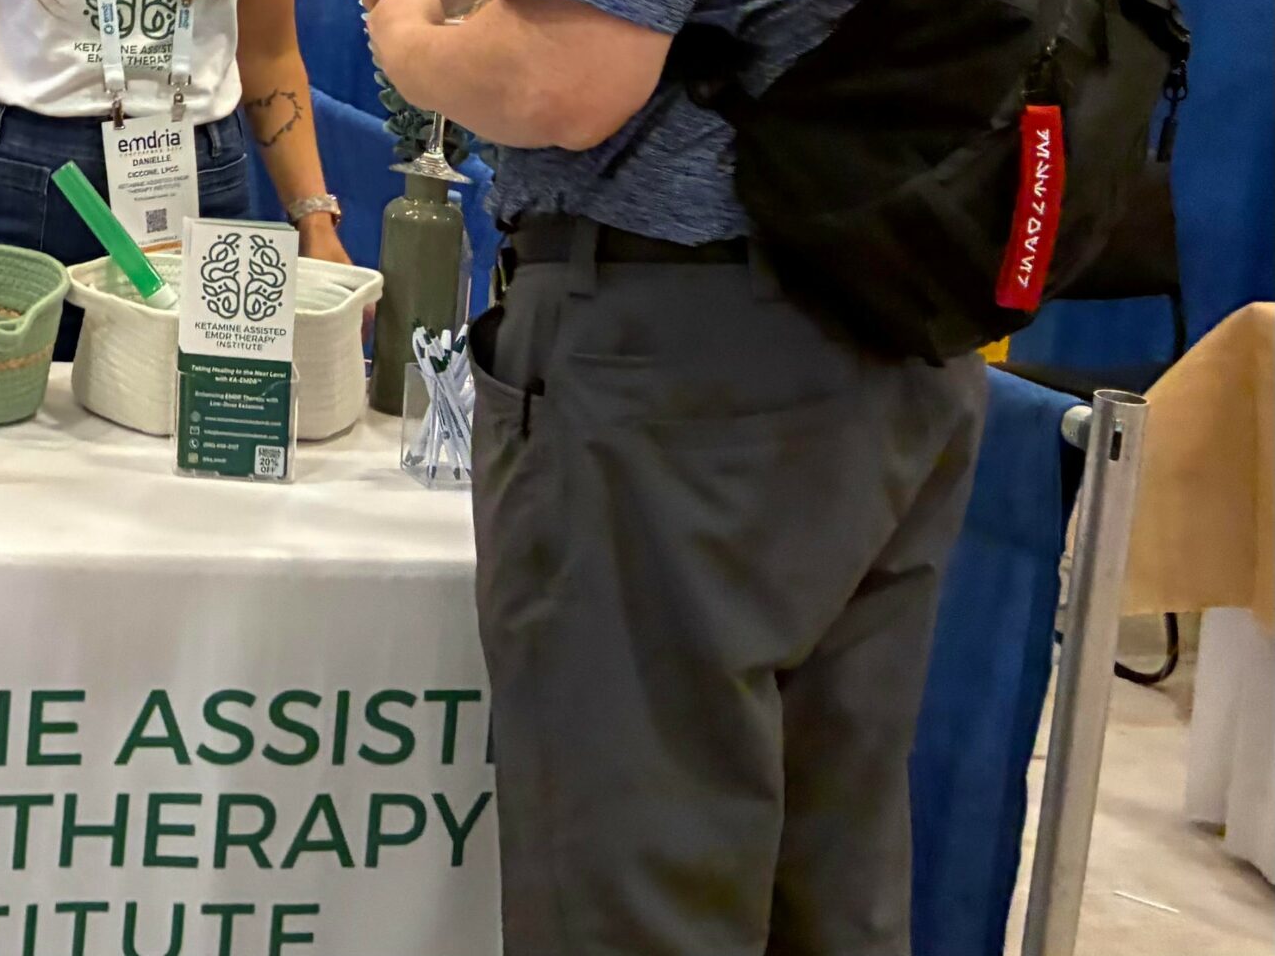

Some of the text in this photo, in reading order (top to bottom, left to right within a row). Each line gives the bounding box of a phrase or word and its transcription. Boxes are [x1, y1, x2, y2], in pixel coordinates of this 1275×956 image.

[118, 129, 180, 152] emdria
[133, 155, 171, 166] DANIELLE
[194, 322, 287, 336] KETAMINE ASSISTED
[205, 331, 275, 343] EMDR THERAPY
[216, 341, 262, 351] INSTITUTE
[114, 689, 493, 766] ASSIST
